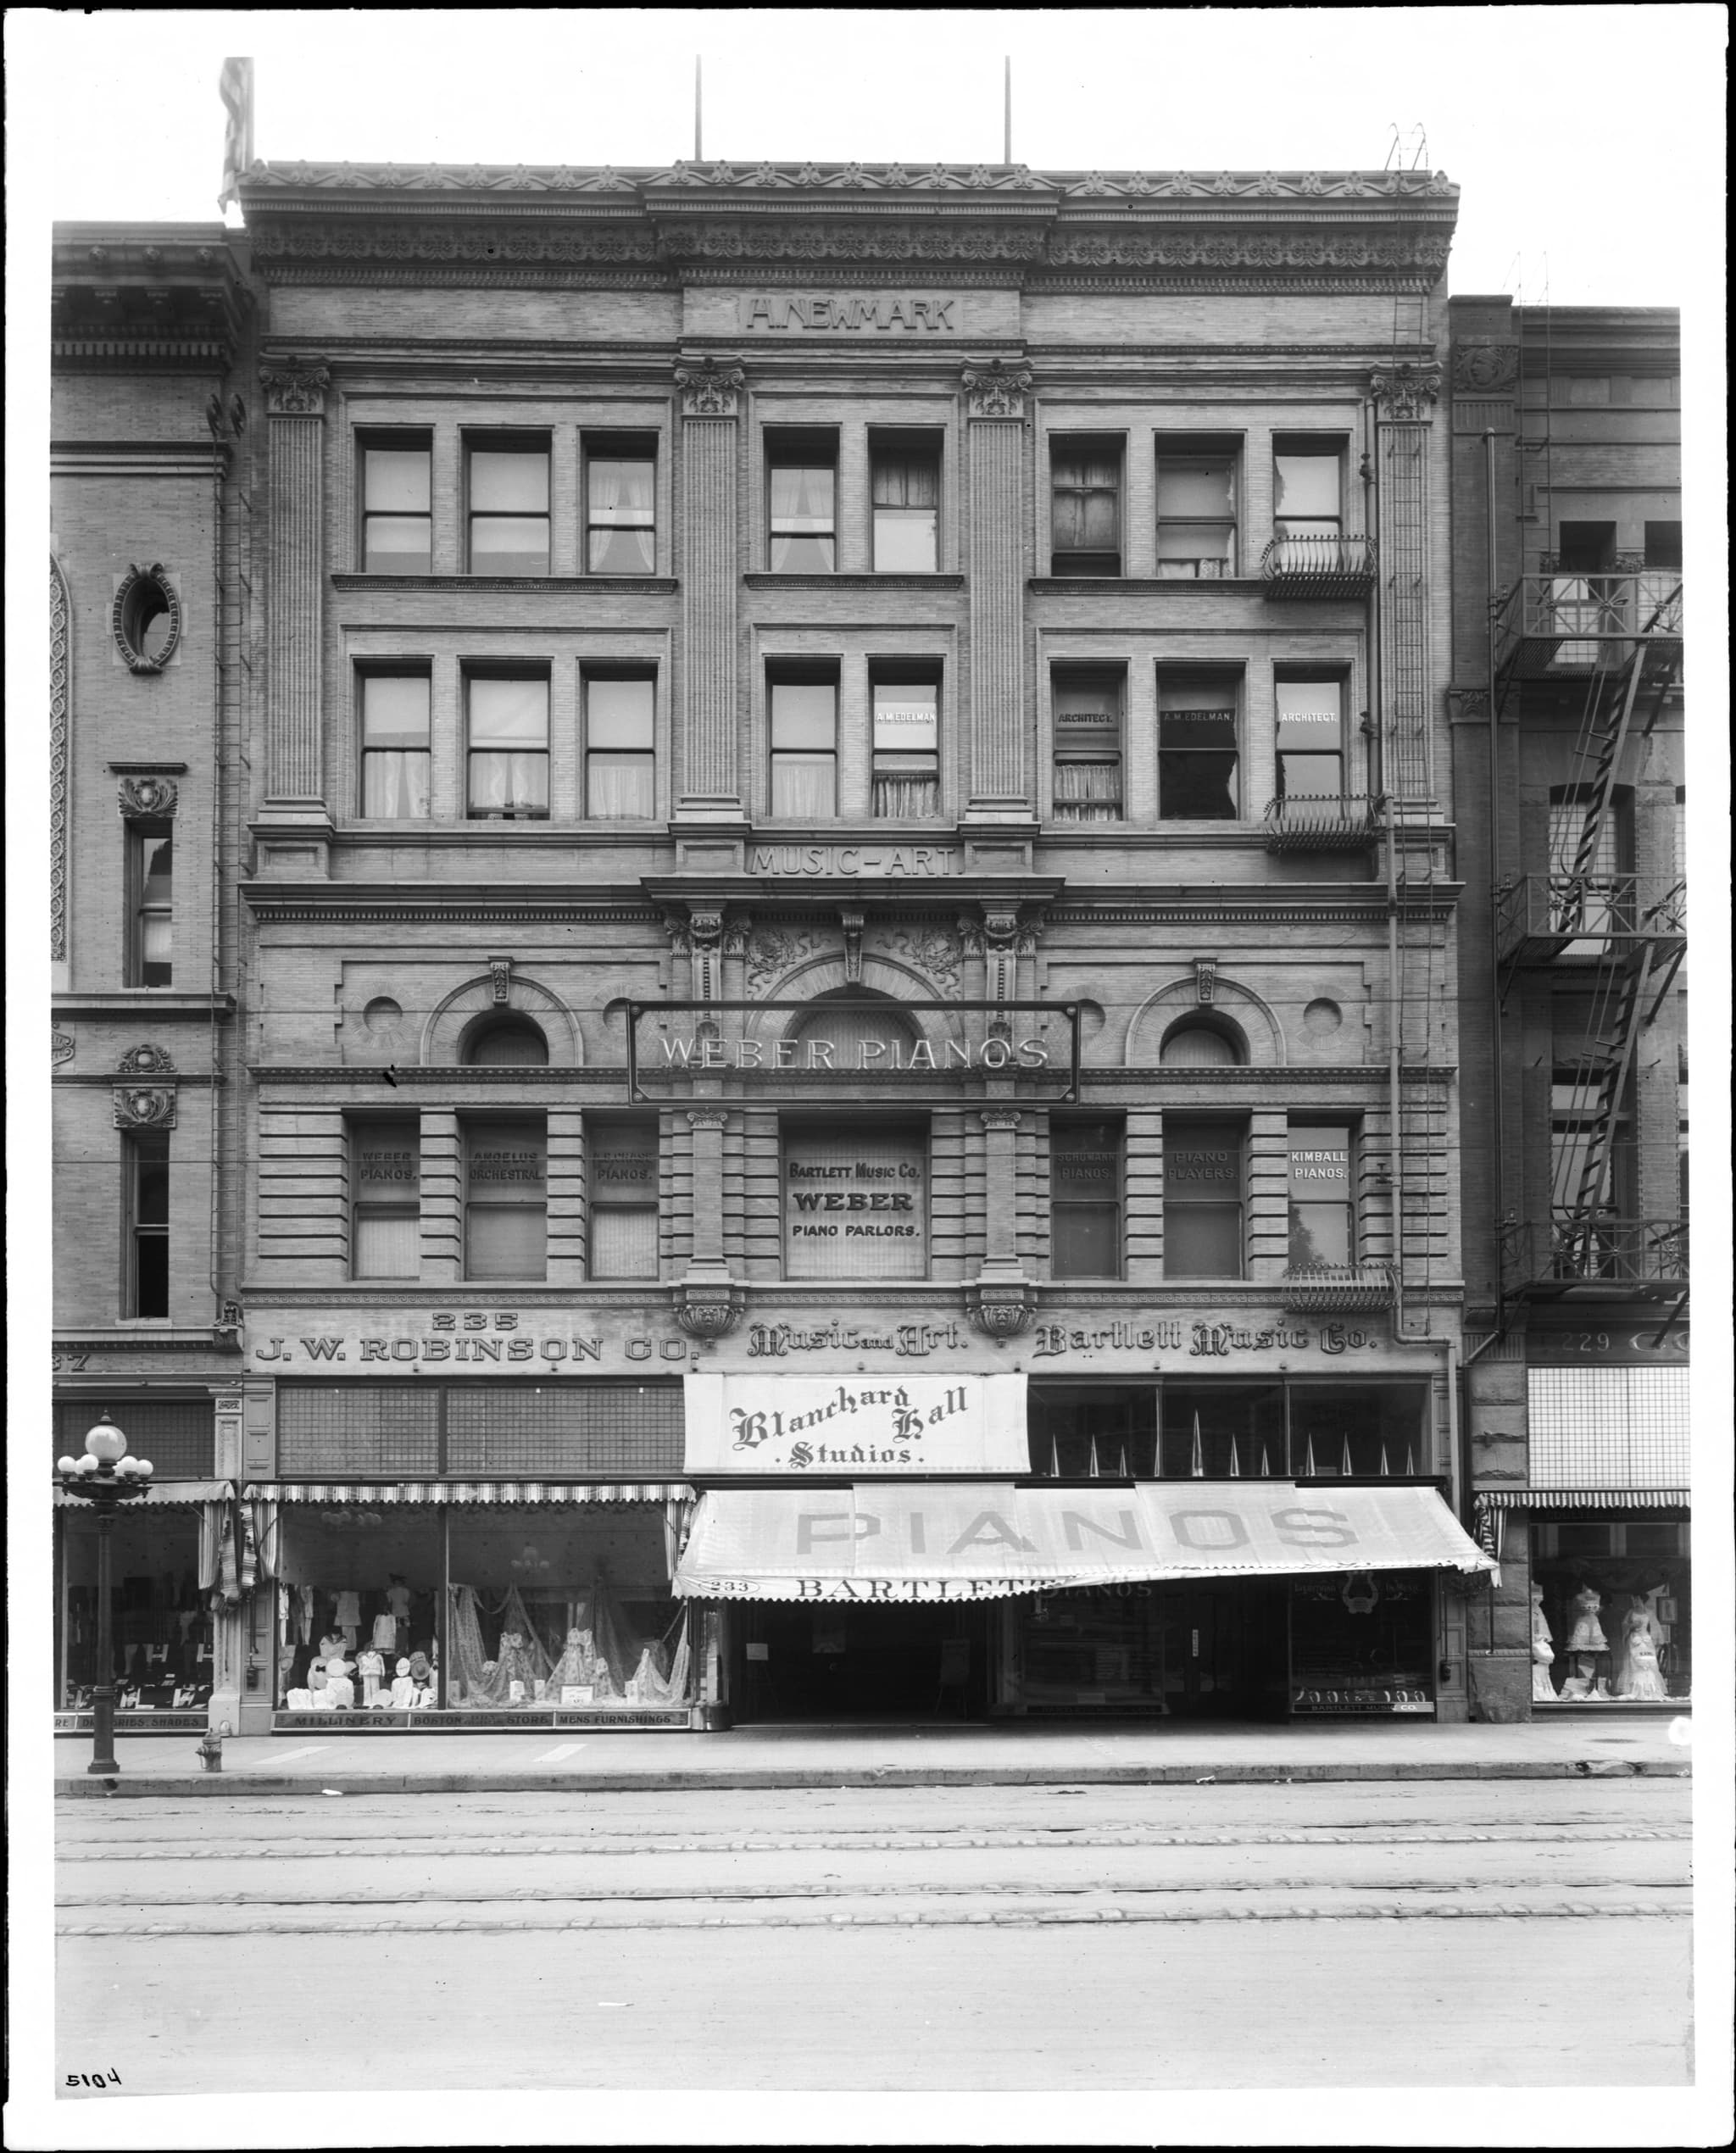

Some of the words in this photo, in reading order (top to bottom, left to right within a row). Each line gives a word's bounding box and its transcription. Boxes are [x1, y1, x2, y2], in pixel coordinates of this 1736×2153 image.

[659, 1038, 835, 1070] WEBER
[856, 1038, 1049, 1071] PIANOS
[362, 1151, 412, 1163] WEBER
[473, 1151, 538, 1163] ANGELUS
[1173, 1151, 1227, 1163] PIANO
[1291, 1151, 1347, 1162] KIMBALL
[360, 1169, 418, 1181] PIANOS.
[469, 1168, 545, 1181] ORCHESTRAL.
[598, 1169, 652, 1181] PIANOS.
[789, 1161, 852, 1178] BARTLETT
[855, 1161, 896, 1178] MUSIC
[1168, 1167, 1238, 1180] PLAYERS.
[1294, 1167, 1348, 1180] PIANOS.
[793, 1193, 914, 1211] WEBER
[793, 1225, 838, 1237] PIANO
[845, 1225, 921, 1237] PARLORS.
[432, 1312, 519, 1331] 235
[747, 1319, 860, 1357] Music
[860, 1334, 893, 1350] and
[1032, 1321, 1182, 1358] Bartlett
[1189, 1318, 1310, 1356] Music
[1562, 1332, 1610, 1352] 229
[255, 1338, 292, 1361] J.
[359, 1338, 604, 1362] ROBINSON
[625, 1338, 699, 1361] CO.
[729, 1384, 913, 1451] Blanchard
[892, 1386, 969, 1444] Hall
[795, 1506, 1360, 1556] PIANOS
[709, 1581, 749, 1593] 233
[152, 1717, 199, 1727] SHADES
[295, 1716, 397, 1726] MILLINERY
[507, 1715, 549, 1724] STORE
[559, 1715, 591, 1724] MENS
[594, 1715, 671, 1724] FURNISHINGS
